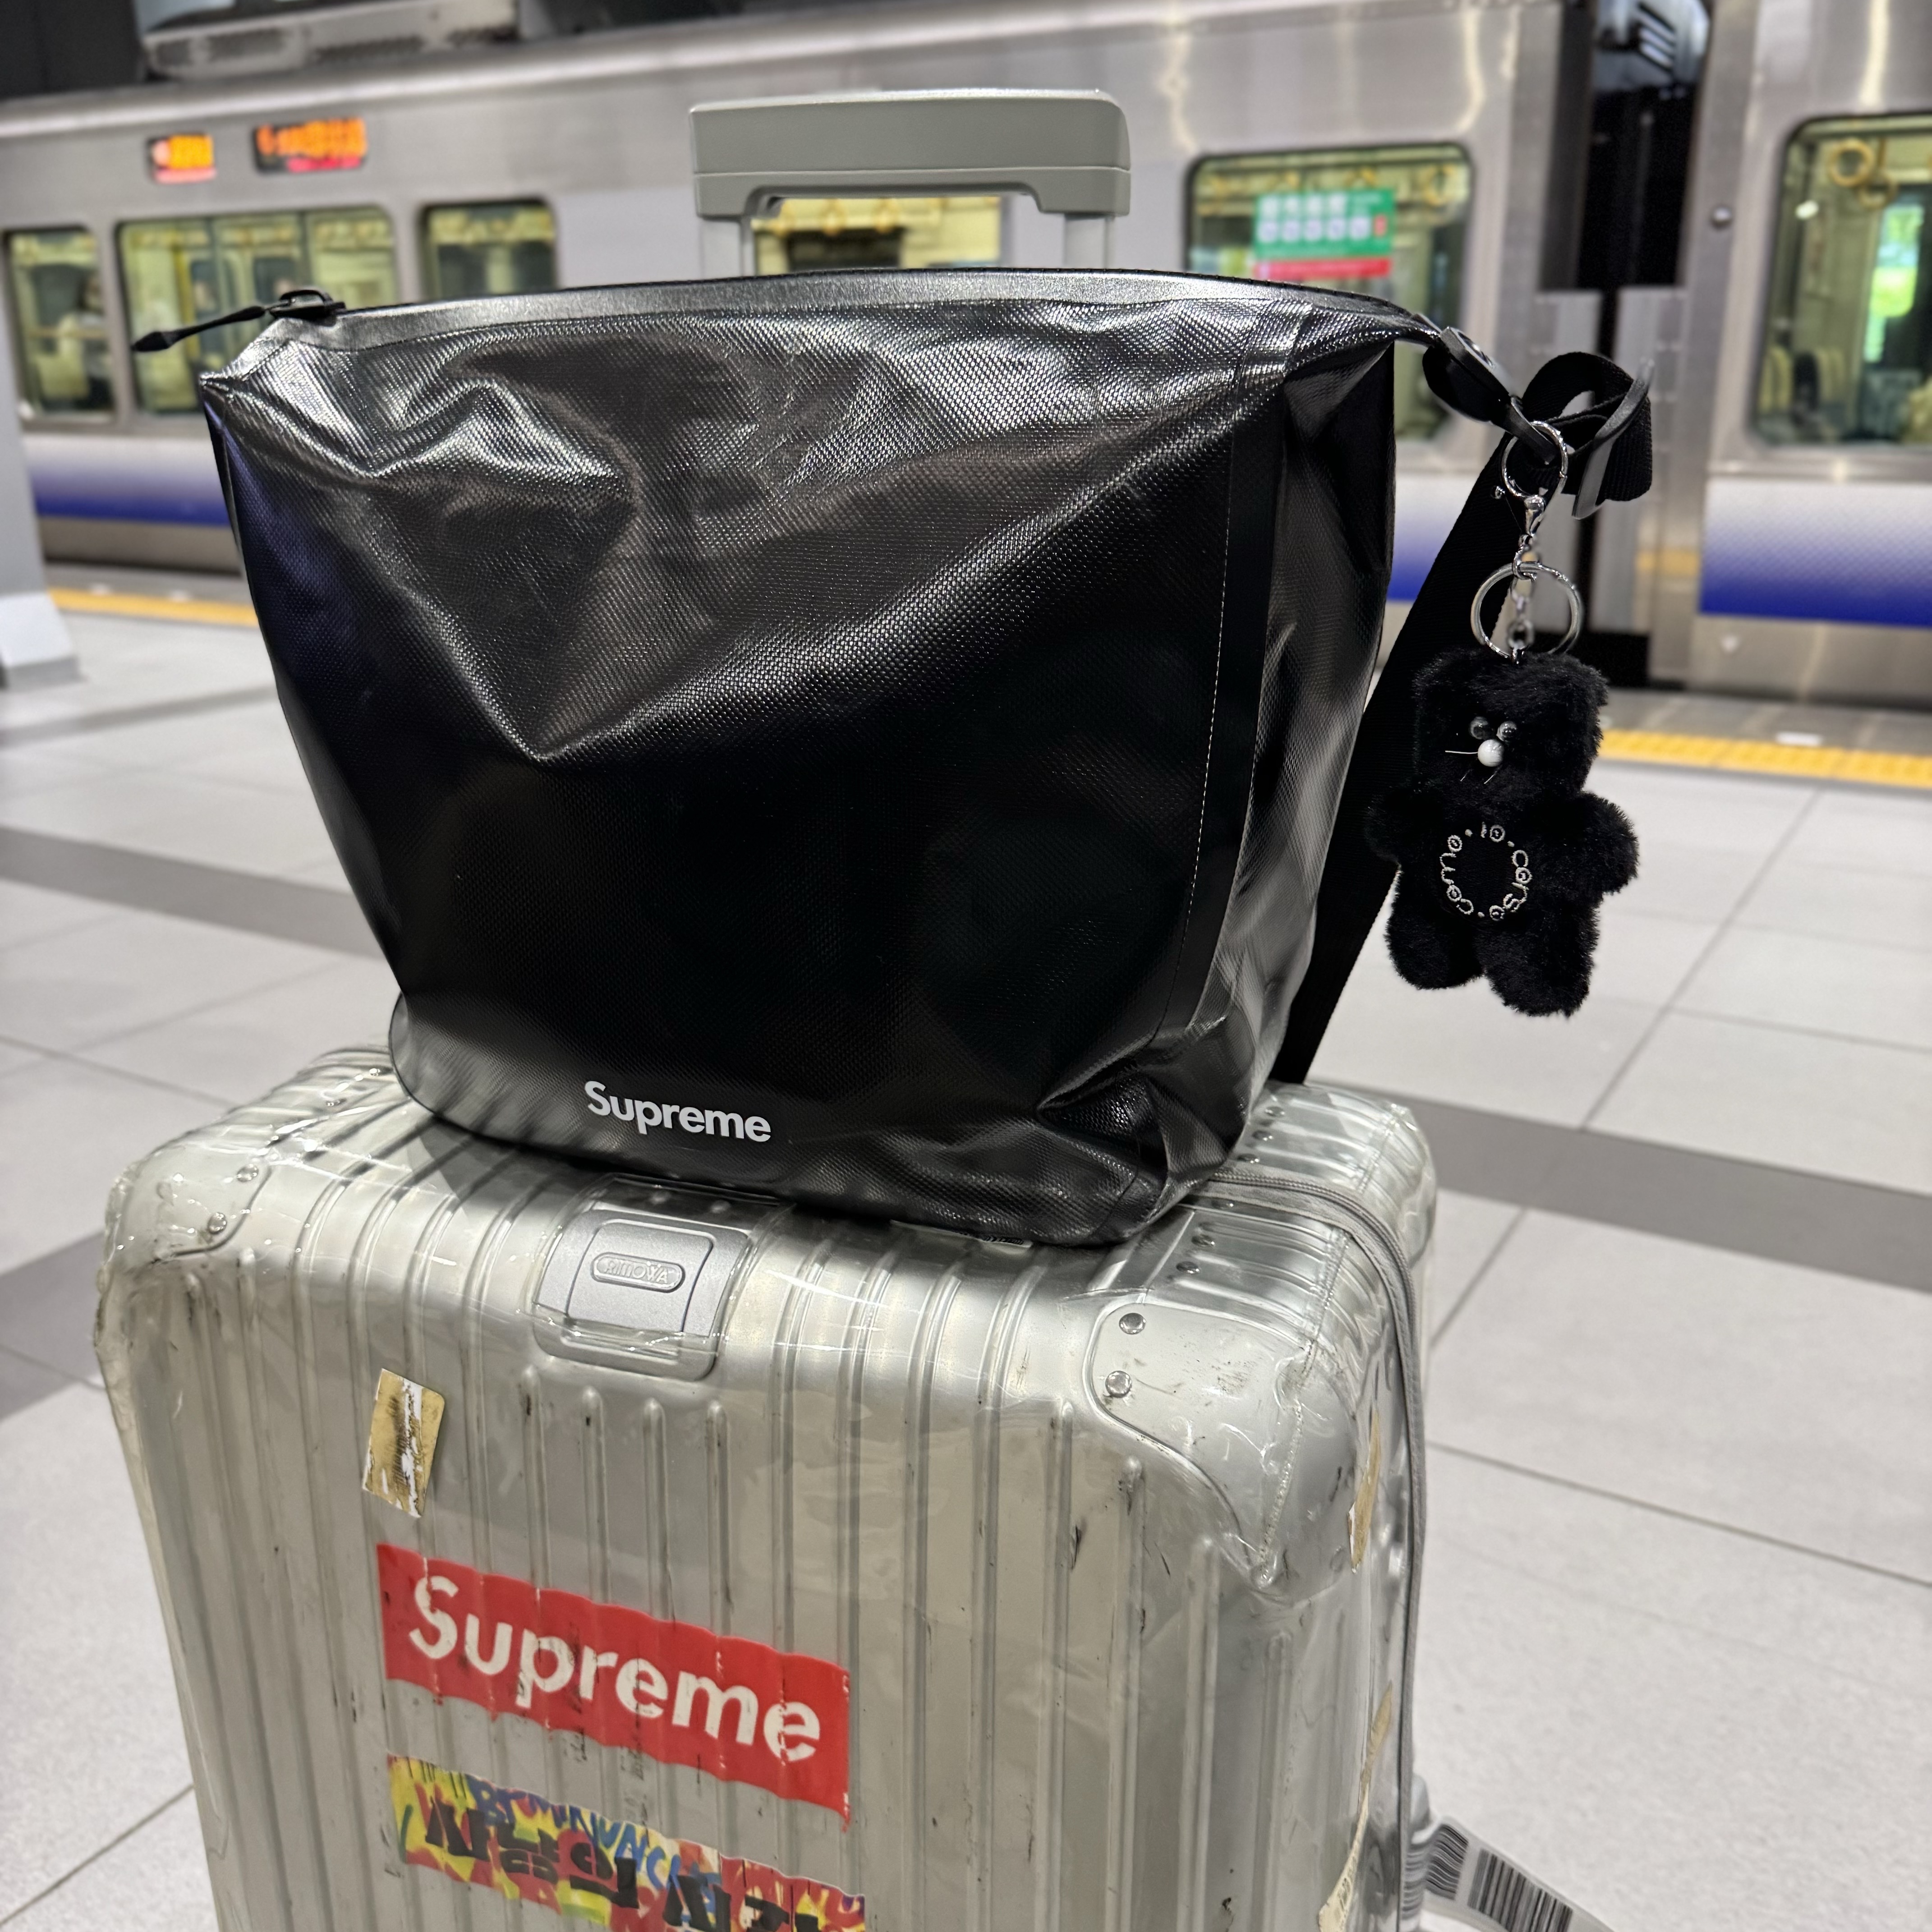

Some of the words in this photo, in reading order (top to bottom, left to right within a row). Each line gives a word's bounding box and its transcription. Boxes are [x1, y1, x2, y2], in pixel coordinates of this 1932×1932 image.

[585, 1081, 771, 1142] Supreme
[604, 1259, 669, 1284] RIMOWA
[409, 1576, 821, 1762] Supreme
